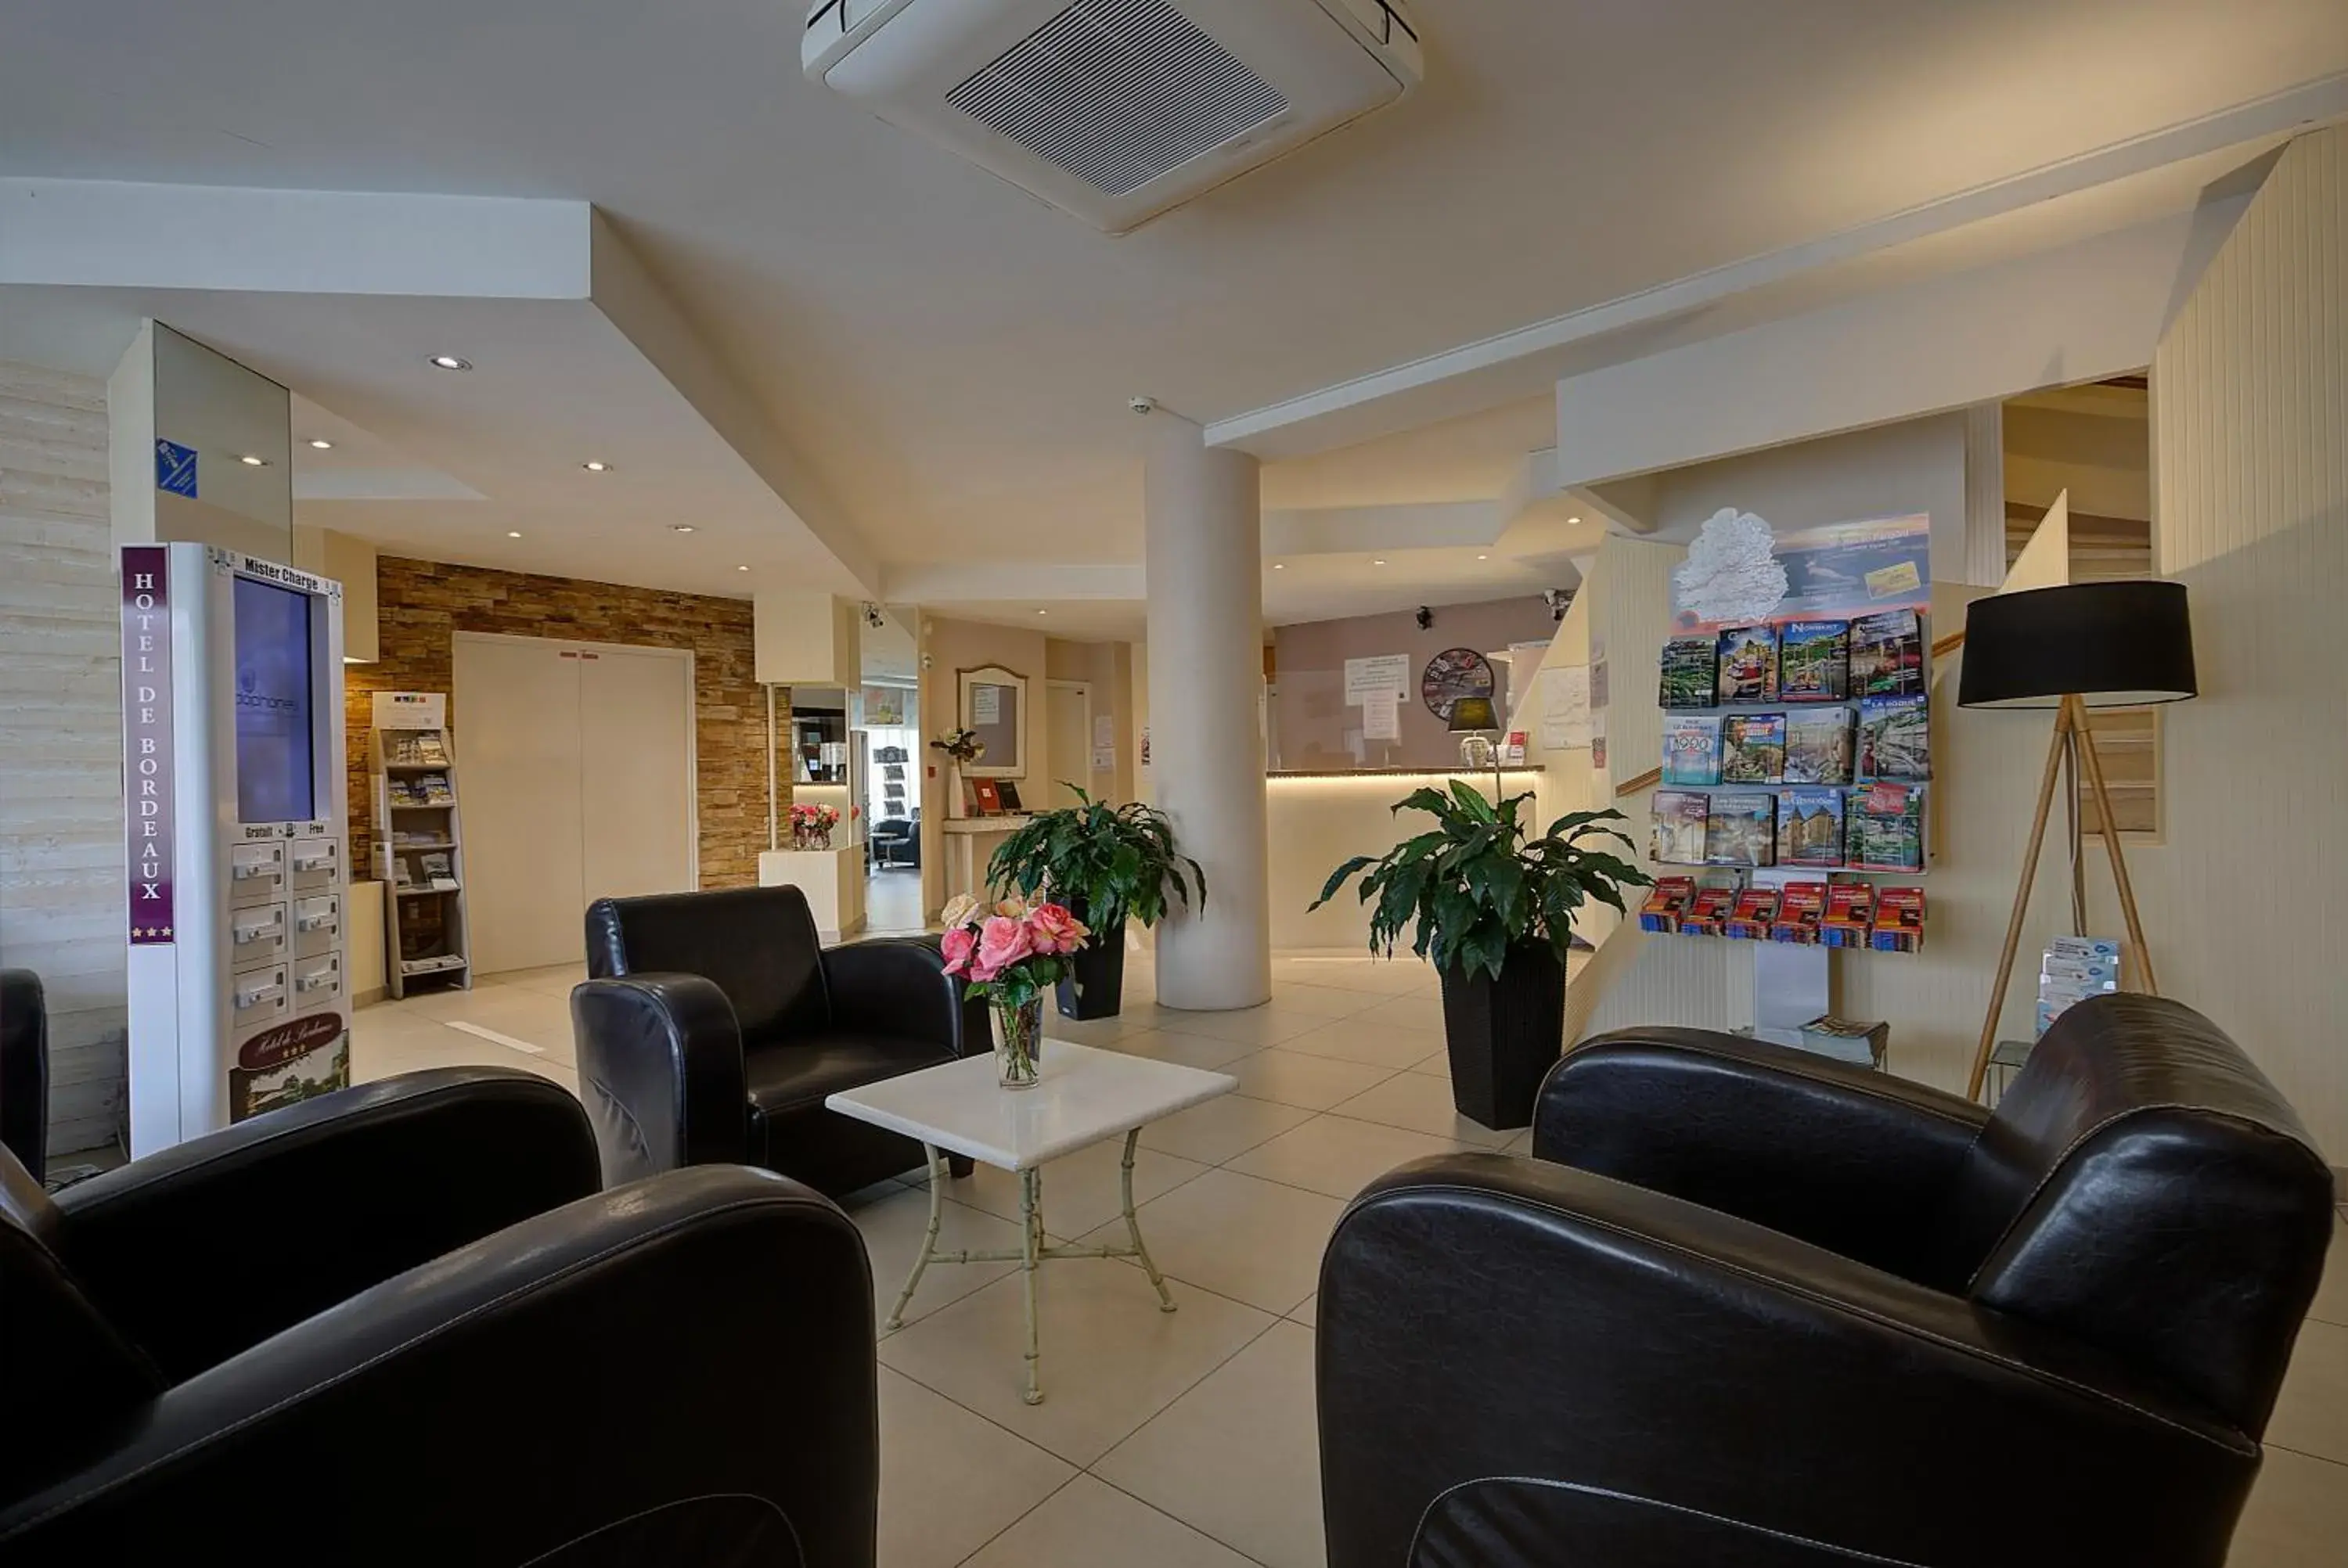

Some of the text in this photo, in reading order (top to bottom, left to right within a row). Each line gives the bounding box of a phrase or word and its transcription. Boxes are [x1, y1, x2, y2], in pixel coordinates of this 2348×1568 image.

[244, 557, 319, 590] Mister Charge
[135, 574, 161, 900] HOTEL DE BORDEAUX
[309, 822, 324, 834] Free
